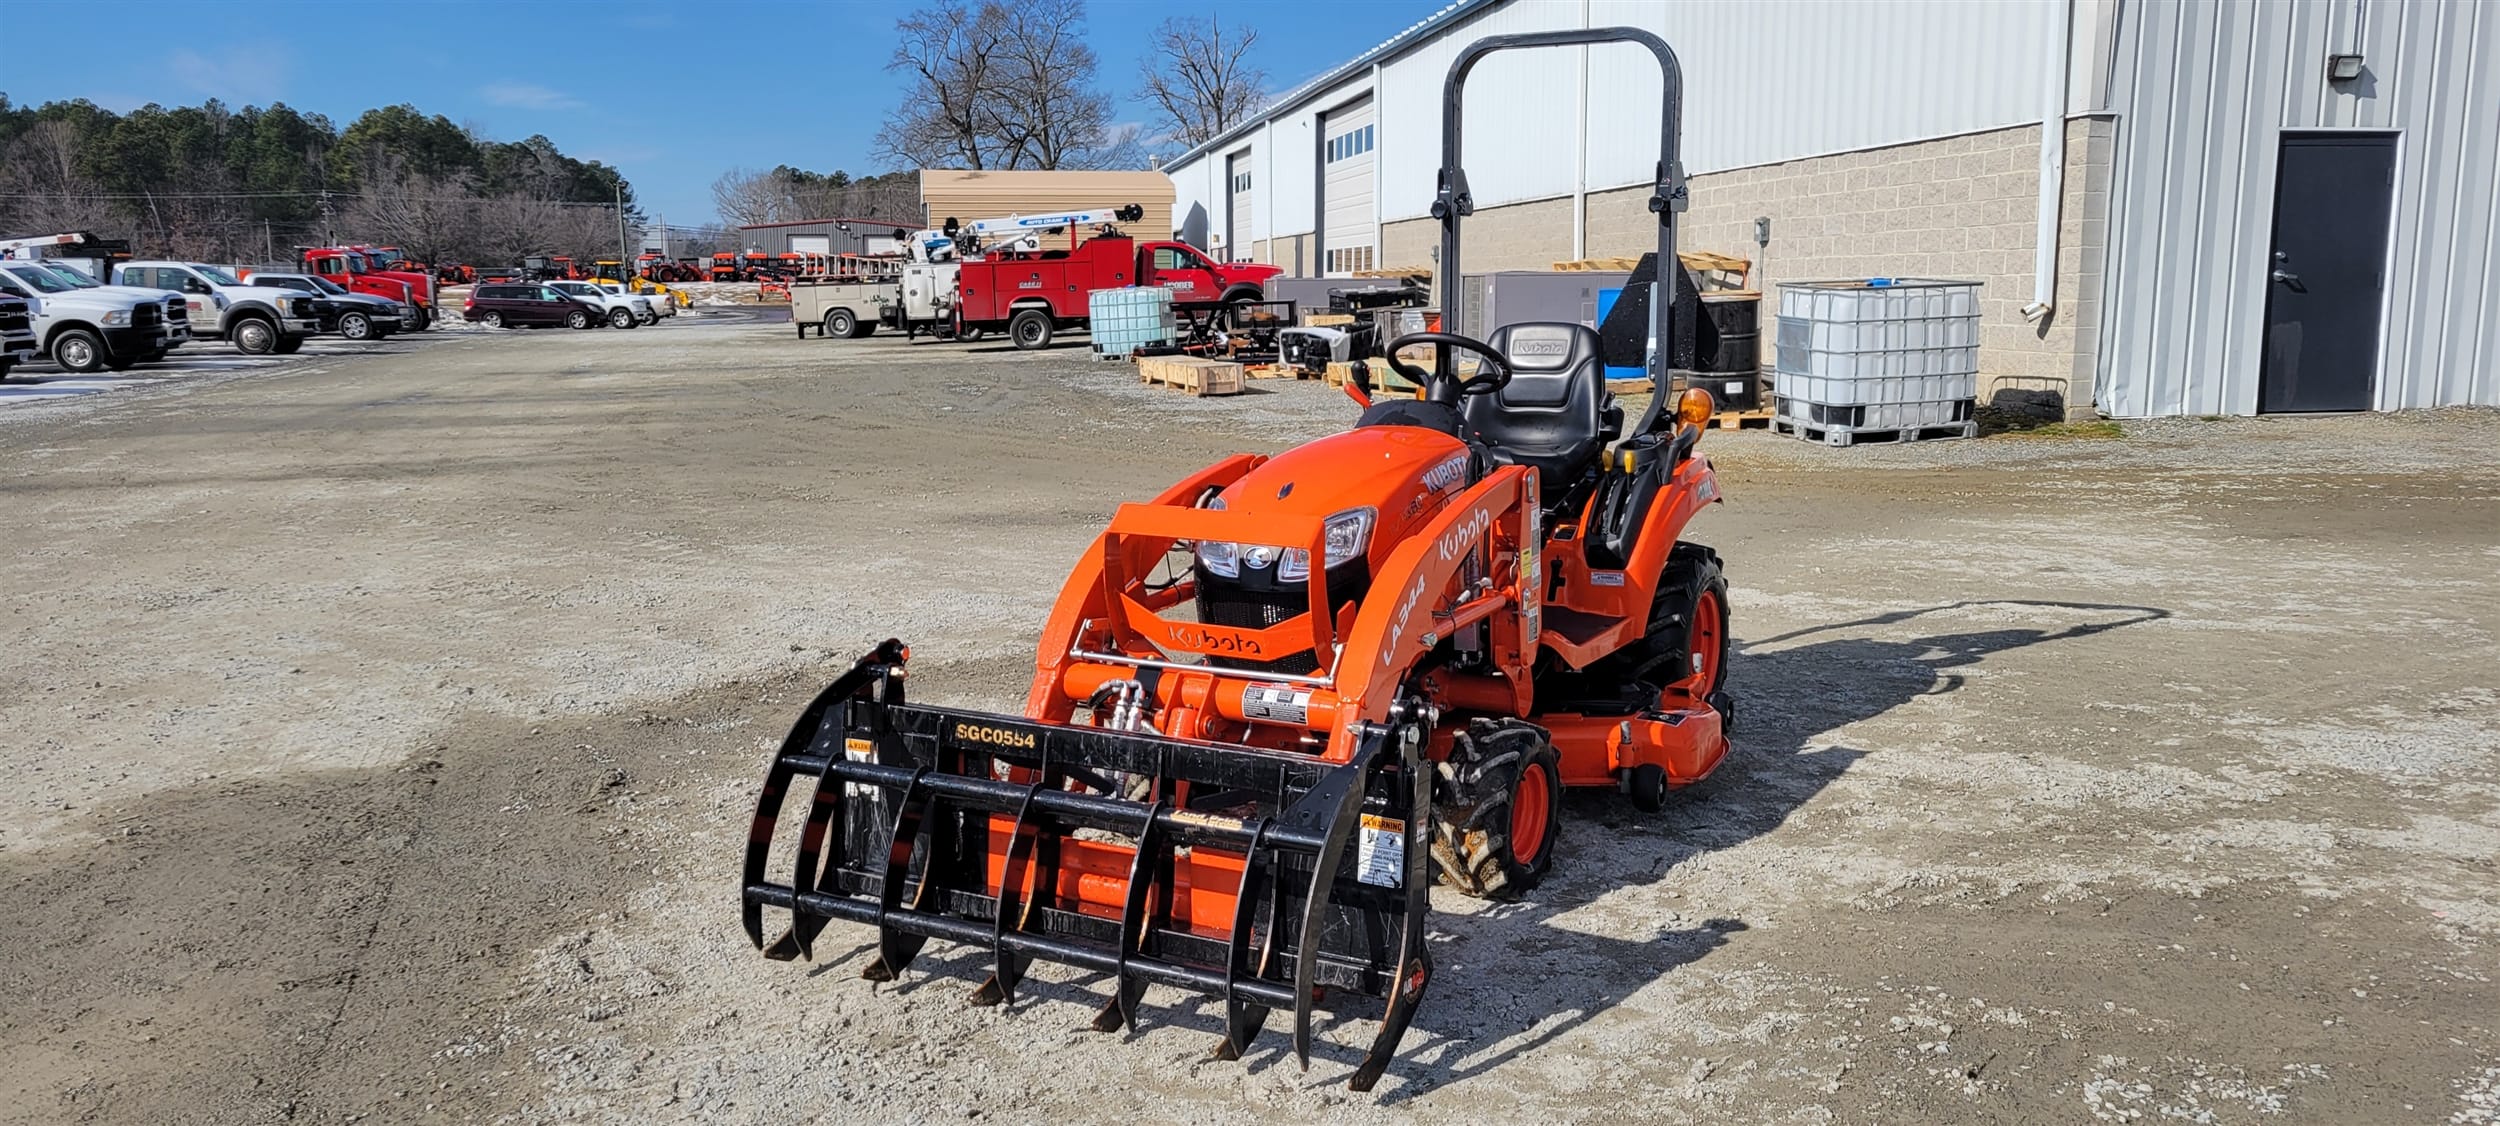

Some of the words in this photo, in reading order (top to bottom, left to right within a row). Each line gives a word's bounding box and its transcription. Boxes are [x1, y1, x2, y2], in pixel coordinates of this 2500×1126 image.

[1517, 342, 1564, 354] Kubota
[1439, 507, 1489, 561] Kubota
[1383, 573, 1426, 667] LA344
[1168, 626, 1261, 654] Kubota
[956, 723, 1036, 749] SGC0554
[1372, 816, 1402, 831] WARNING
